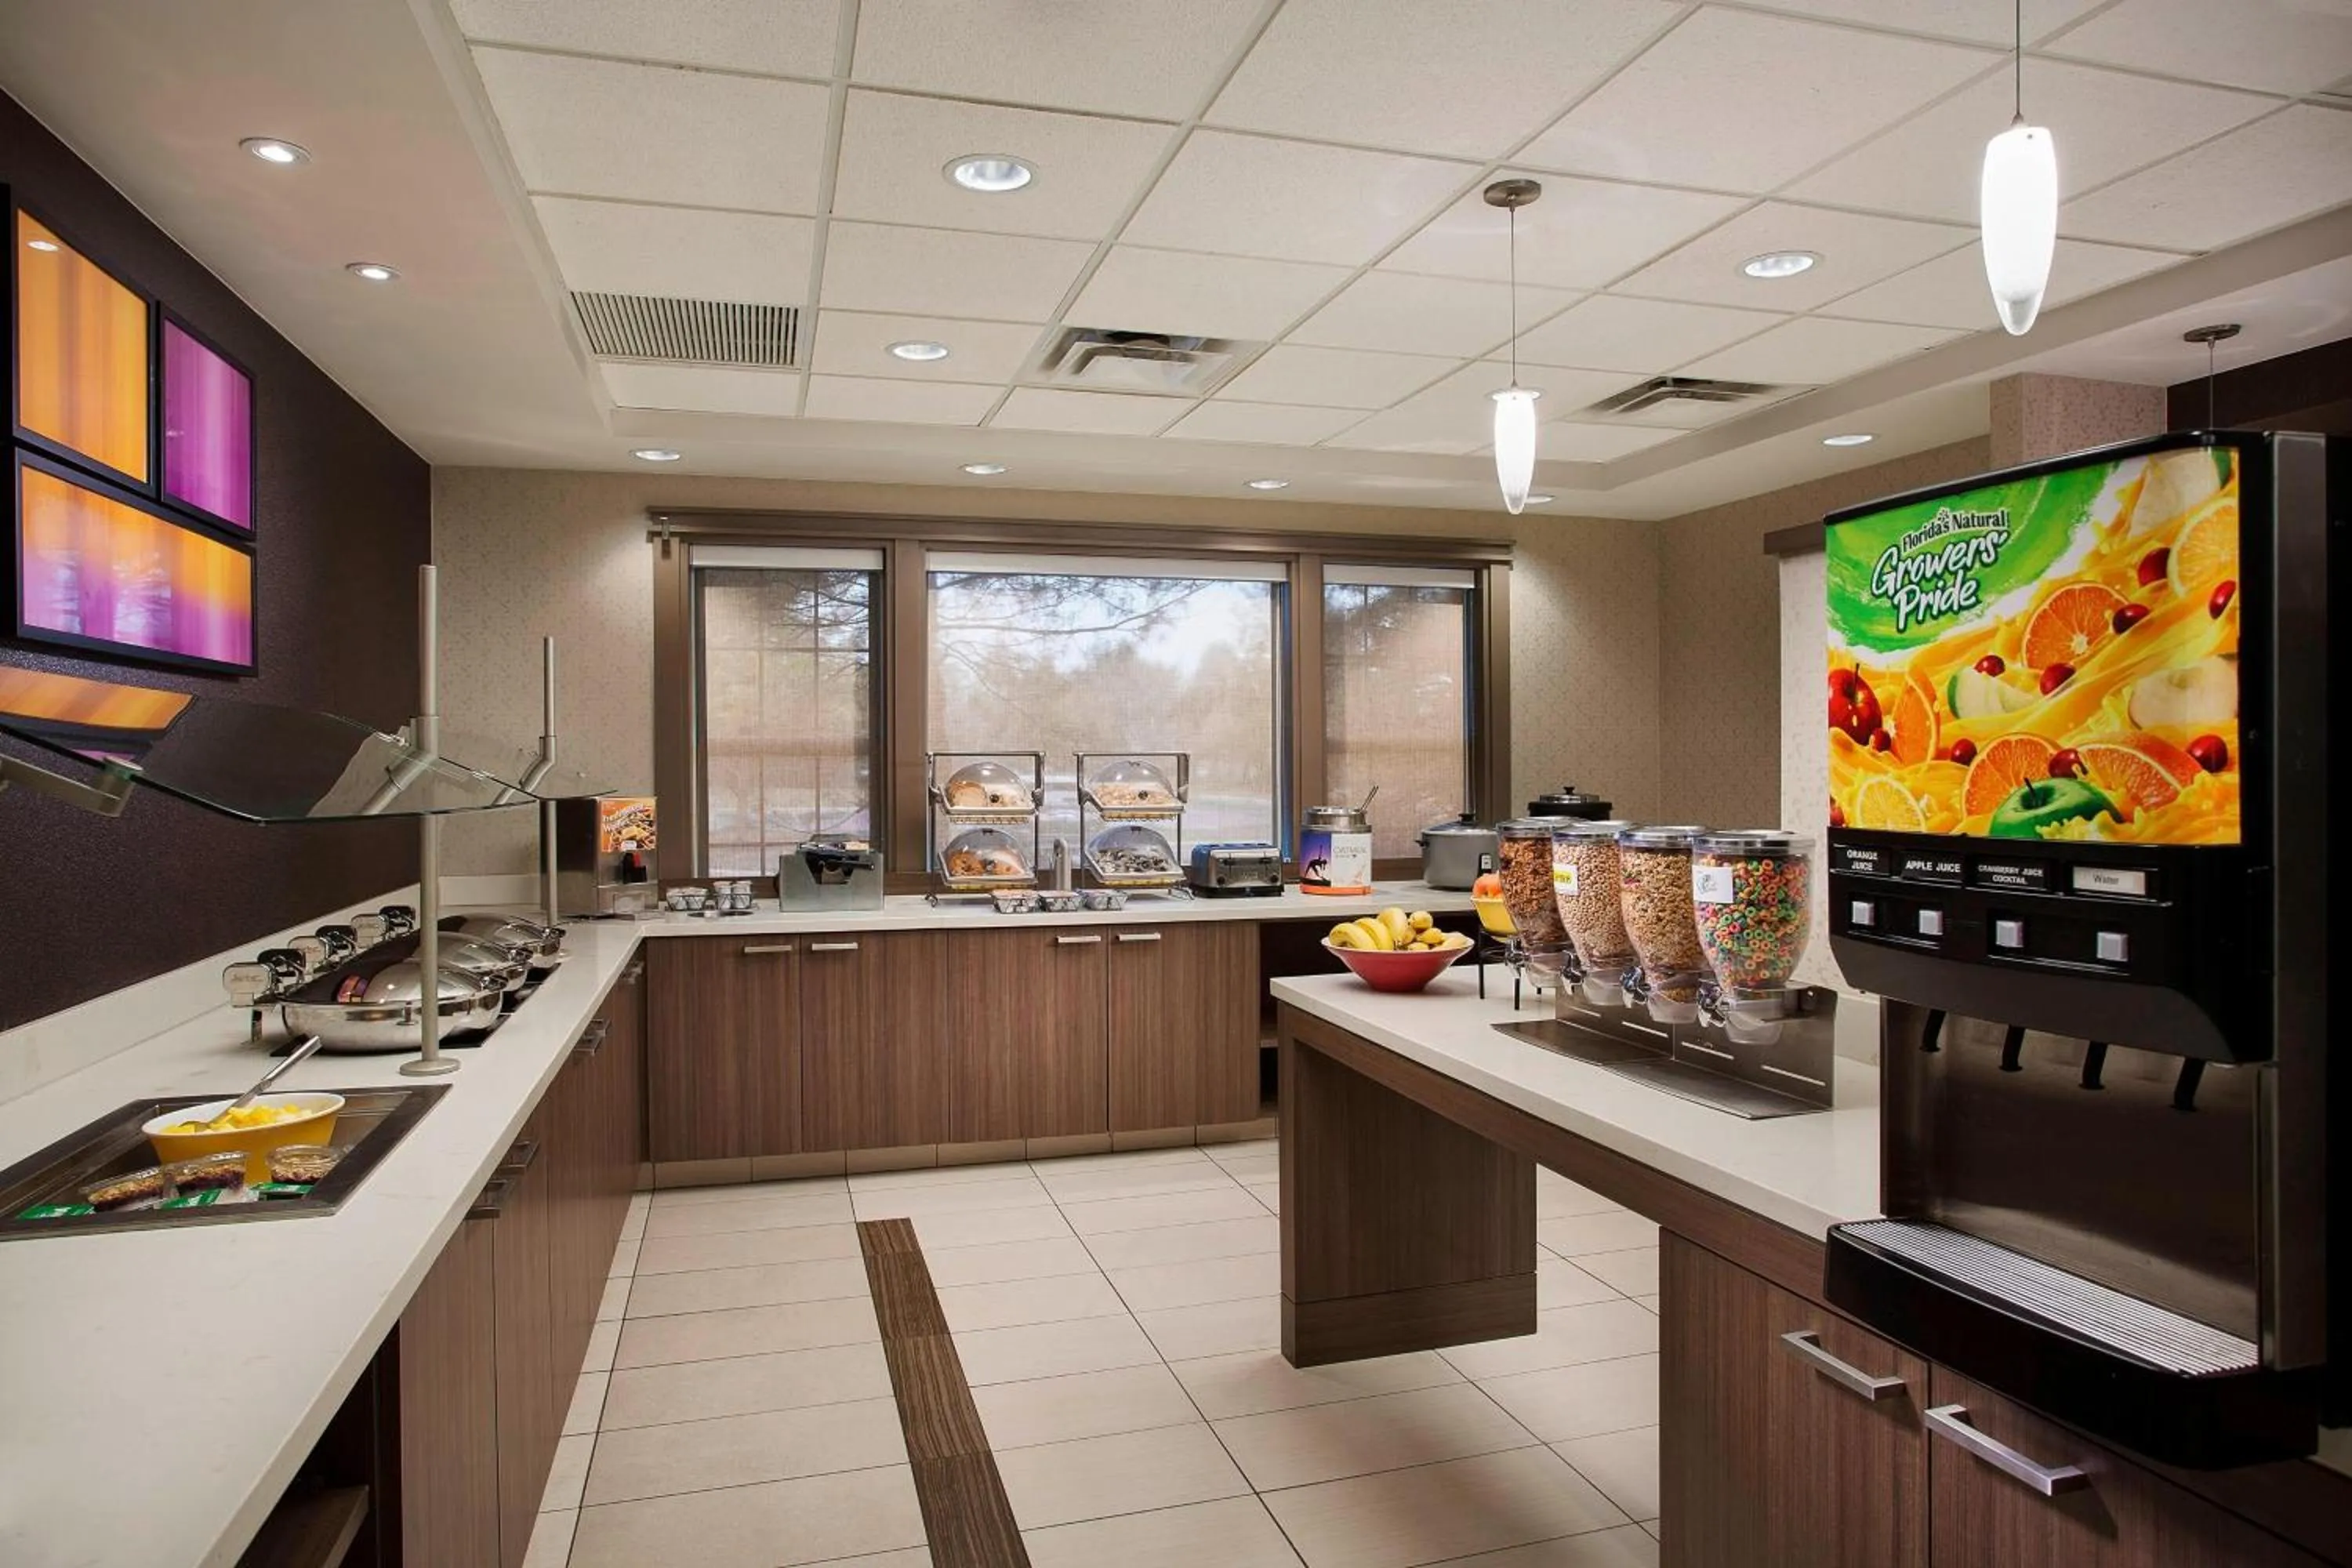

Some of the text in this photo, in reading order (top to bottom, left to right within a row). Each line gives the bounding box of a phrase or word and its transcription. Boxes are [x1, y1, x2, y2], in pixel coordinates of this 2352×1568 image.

[1952, 510, 2006, 530] Natural
[1892, 569, 1977, 631] Pride
[1846, 849, 1878, 860] ORANGE
[1851, 861, 1873, 871] JUICE
[1904, 860, 1961, 873] APPLE JUICE
[1978, 865, 2044, 877] CRANBERRY JUICE
[1992, 874, 2028, 884] COCKTAIL
[2092, 872, 2119, 885] Water
